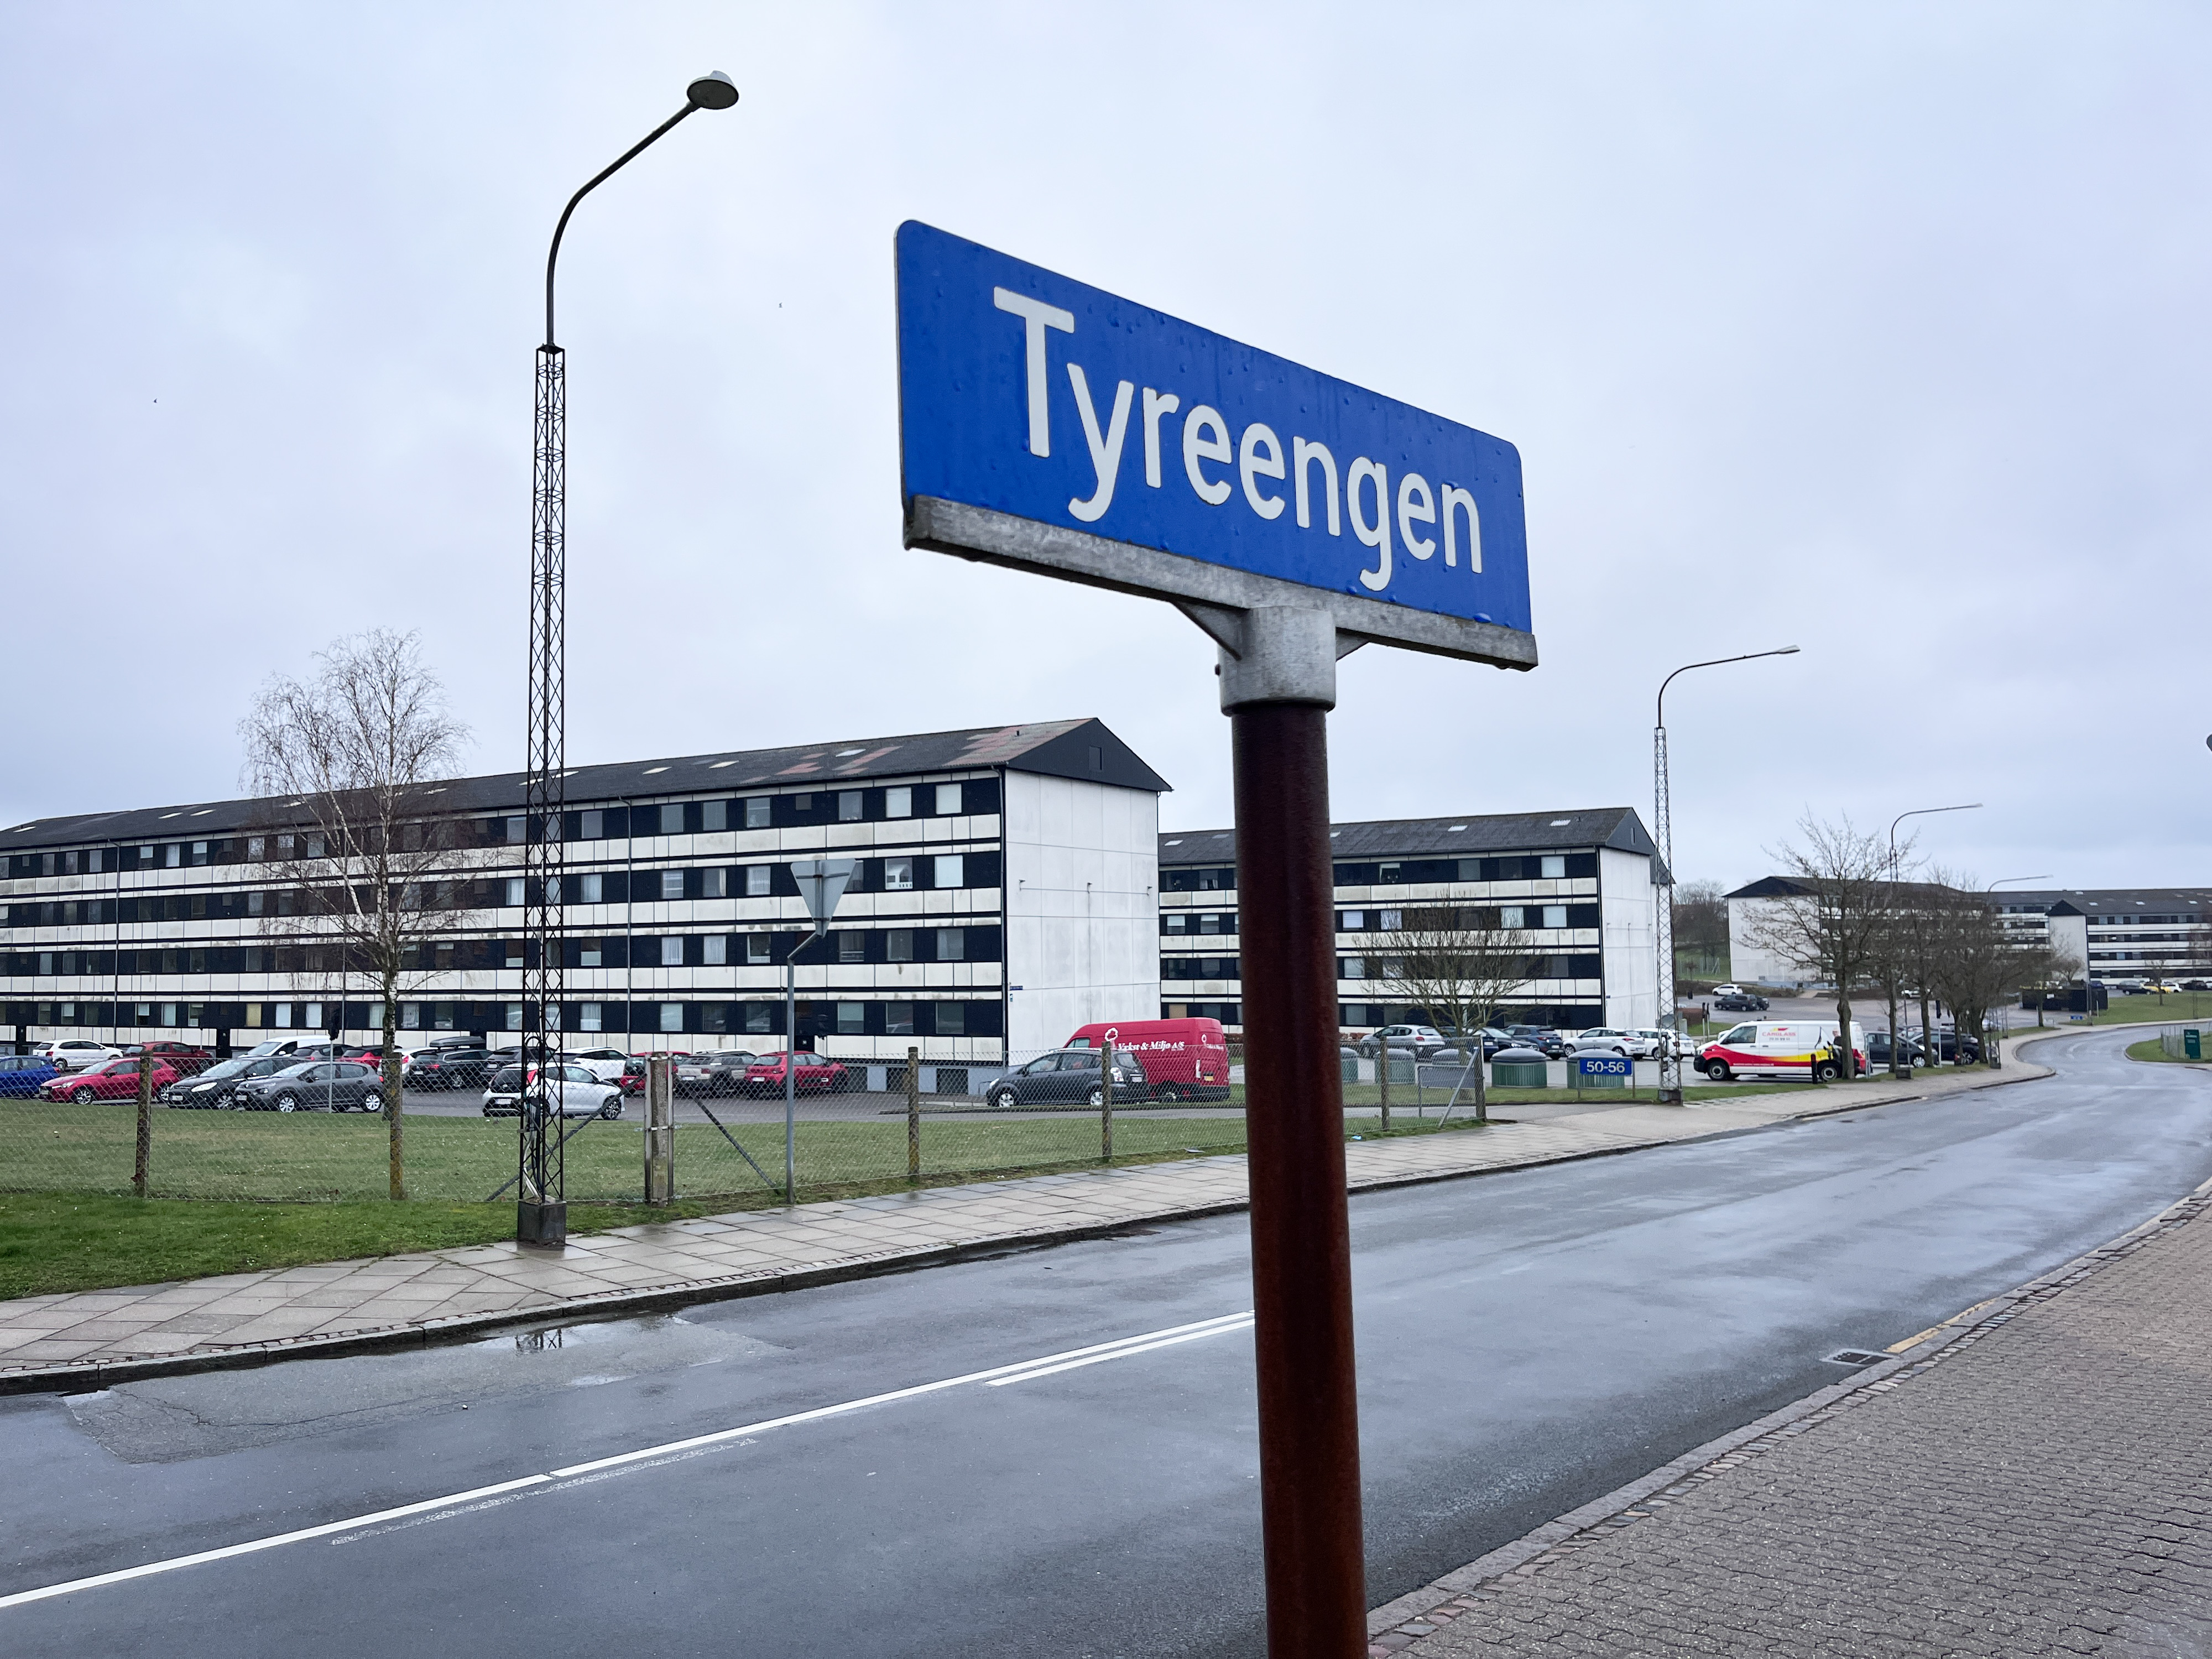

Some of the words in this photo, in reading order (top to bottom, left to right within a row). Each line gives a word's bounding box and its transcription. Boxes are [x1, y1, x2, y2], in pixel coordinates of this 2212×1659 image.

[994, 286, 1482, 591] Tyreengen
[1140, 1042, 1149, 1050] &
[1587, 1061, 1625, 1073] 50-56
